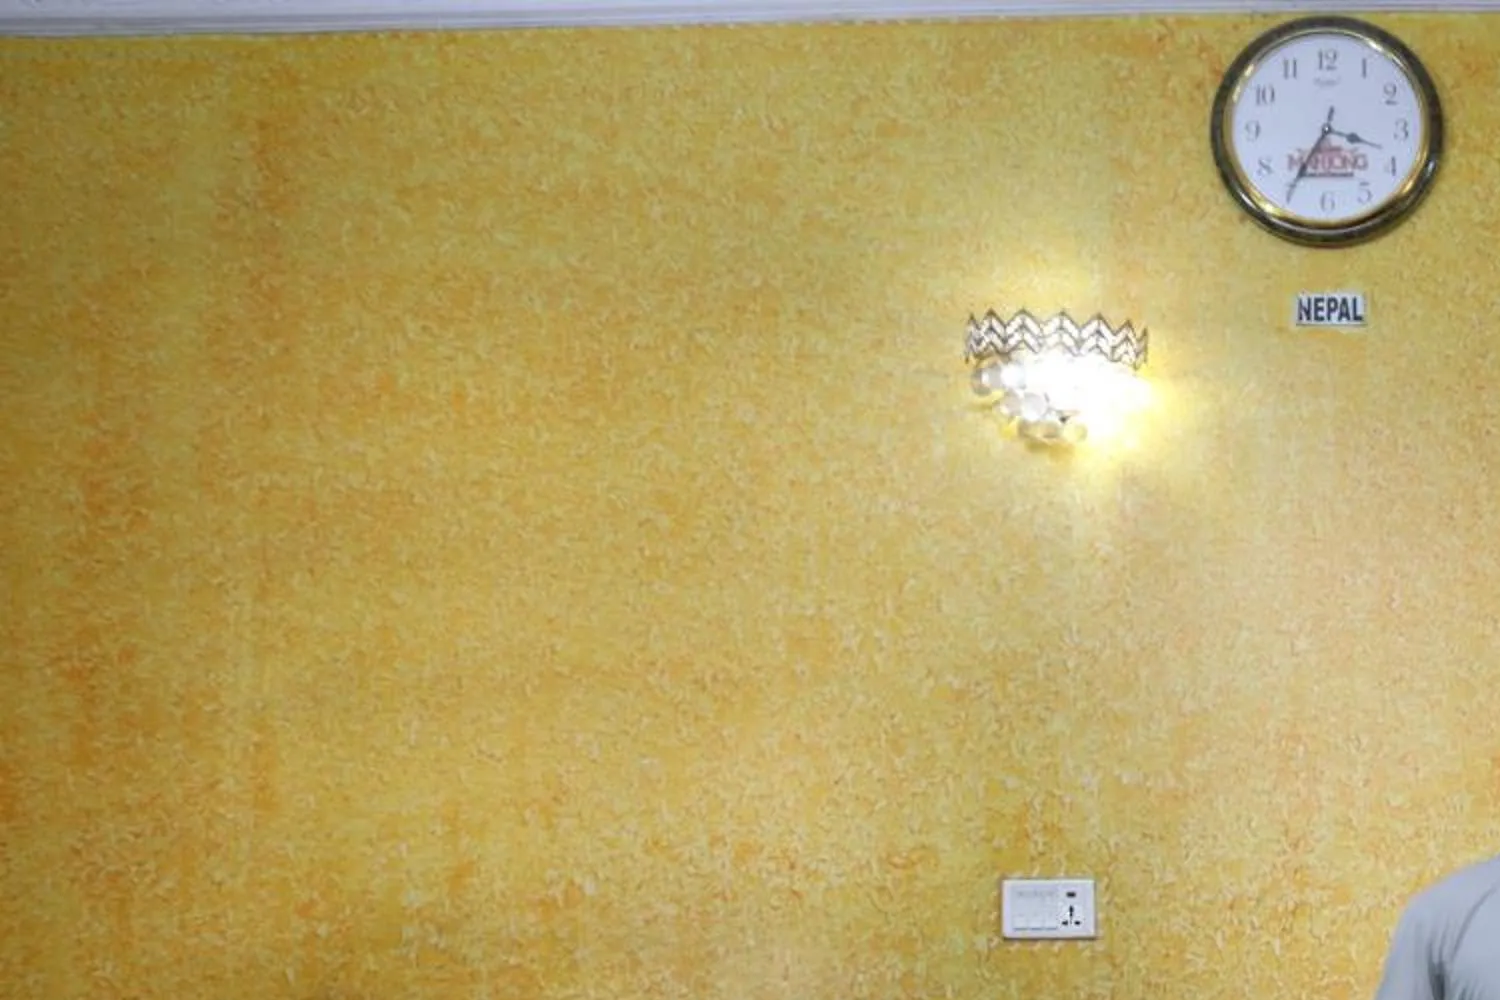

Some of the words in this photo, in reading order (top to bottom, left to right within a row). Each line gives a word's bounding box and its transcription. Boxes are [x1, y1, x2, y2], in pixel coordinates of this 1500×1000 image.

[1283, 58, 1298, 80] 11
[1317, 49, 1338, 71] 12
[1255, 85, 1275, 106] 10
[1383, 83, 1398, 105] 2
[1245, 120, 1261, 141] 9
[1394, 118, 1409, 141] 3
[1257, 156, 1273, 176] 8
[1383, 156, 1397, 177] 4
[1320, 191, 1336, 213] 6
[1357, 182, 1373, 205] 5
[1298, 297, 1363, 322] NEPAL
